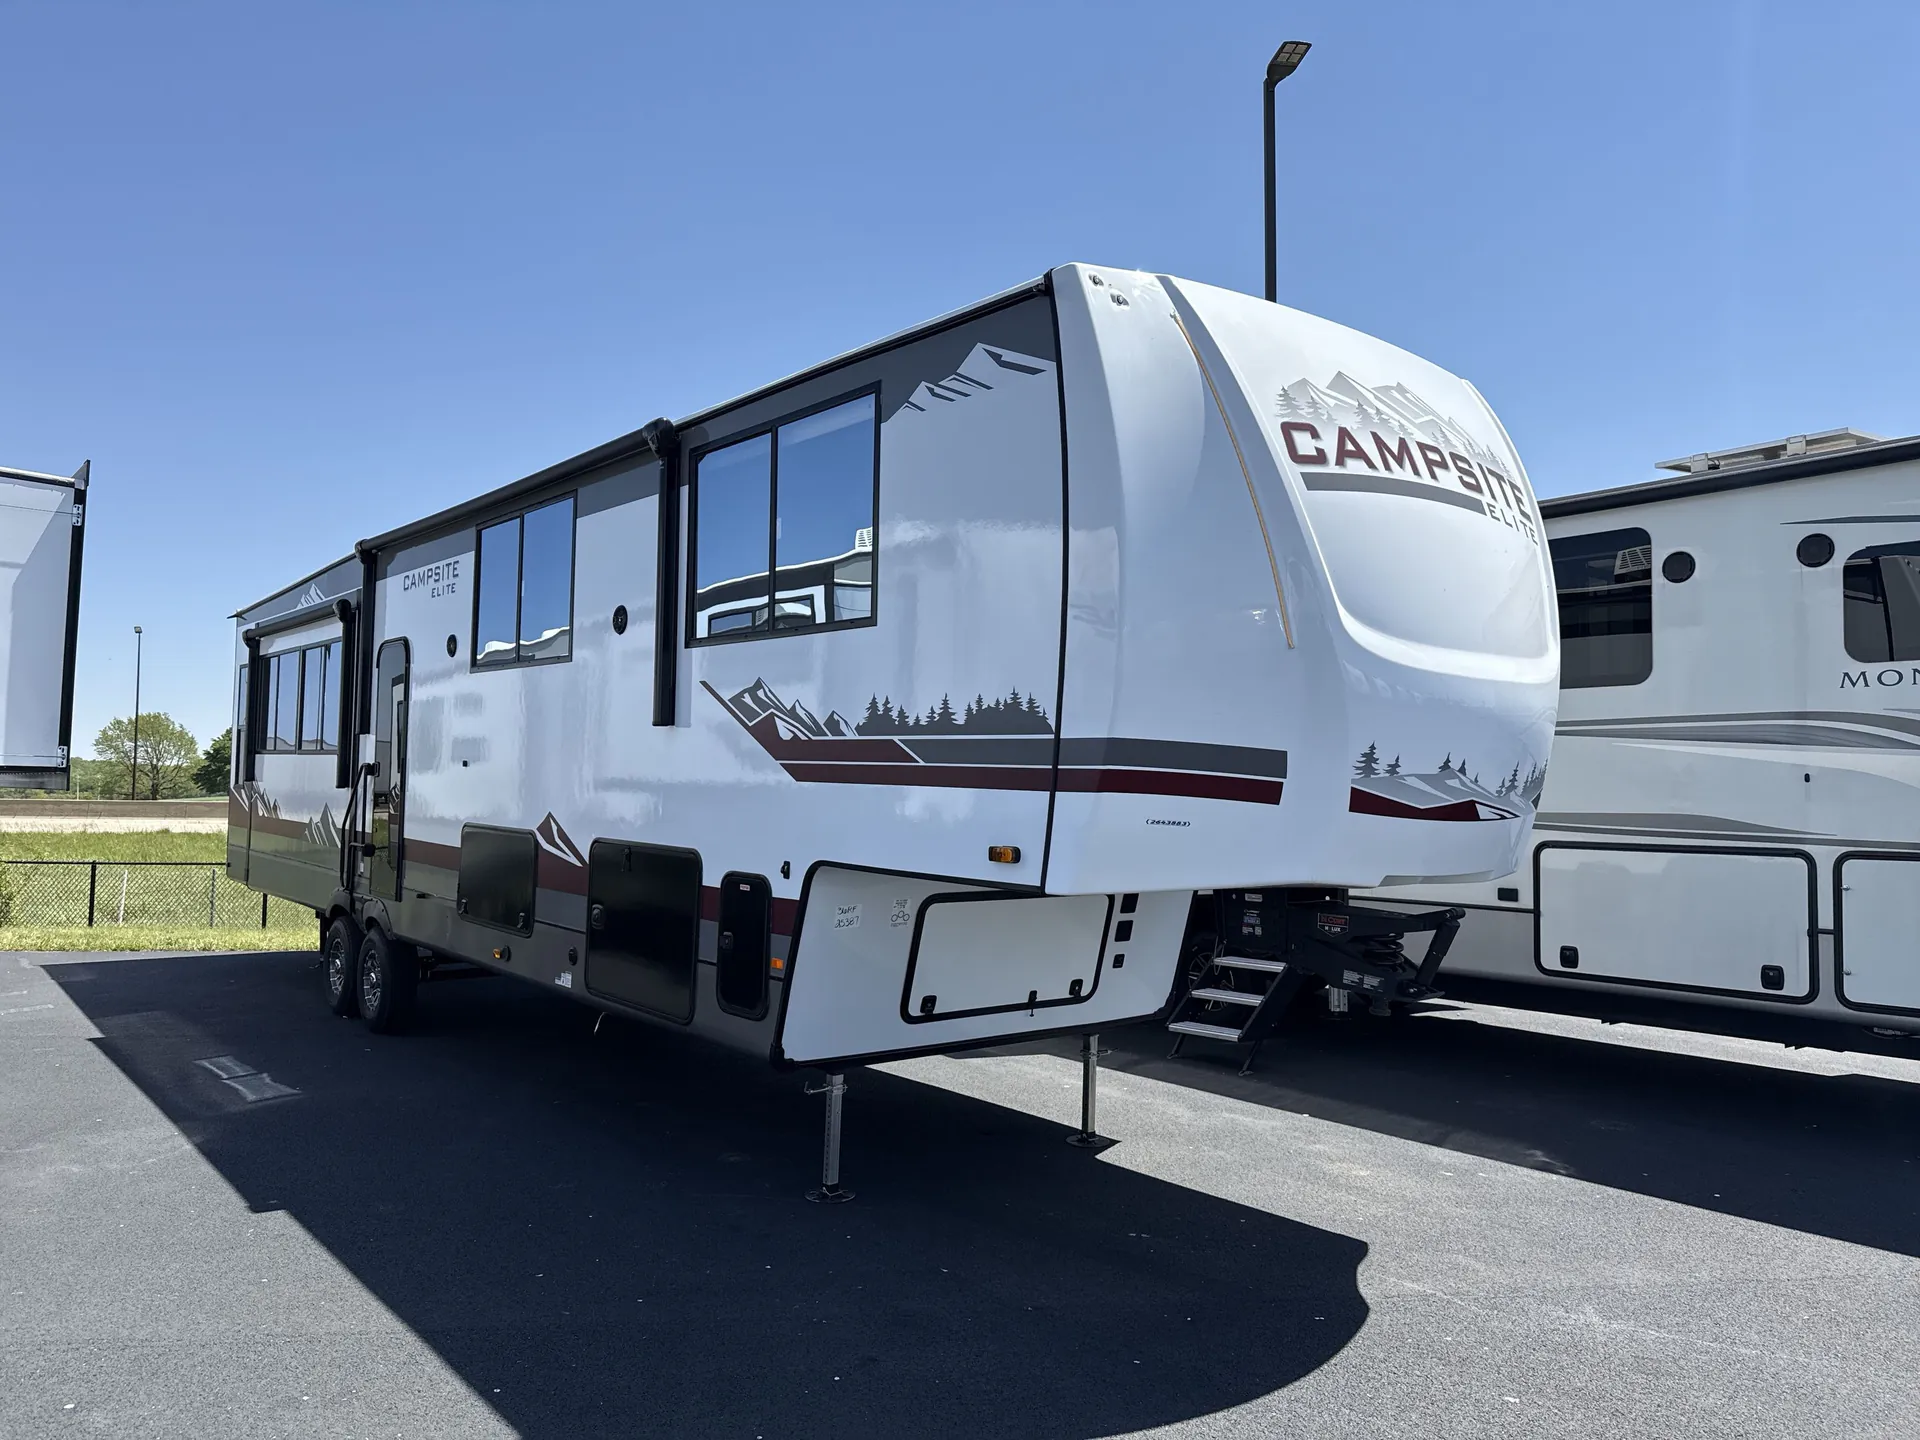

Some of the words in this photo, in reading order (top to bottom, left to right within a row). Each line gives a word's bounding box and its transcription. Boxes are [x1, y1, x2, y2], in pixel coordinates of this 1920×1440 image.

[1280, 421, 1534, 526] CAMPSITE
[1486, 501, 1539, 546] ELITE
[403, 560, 460, 592] CAMPSITE
[431, 582, 456, 599] ELITE
